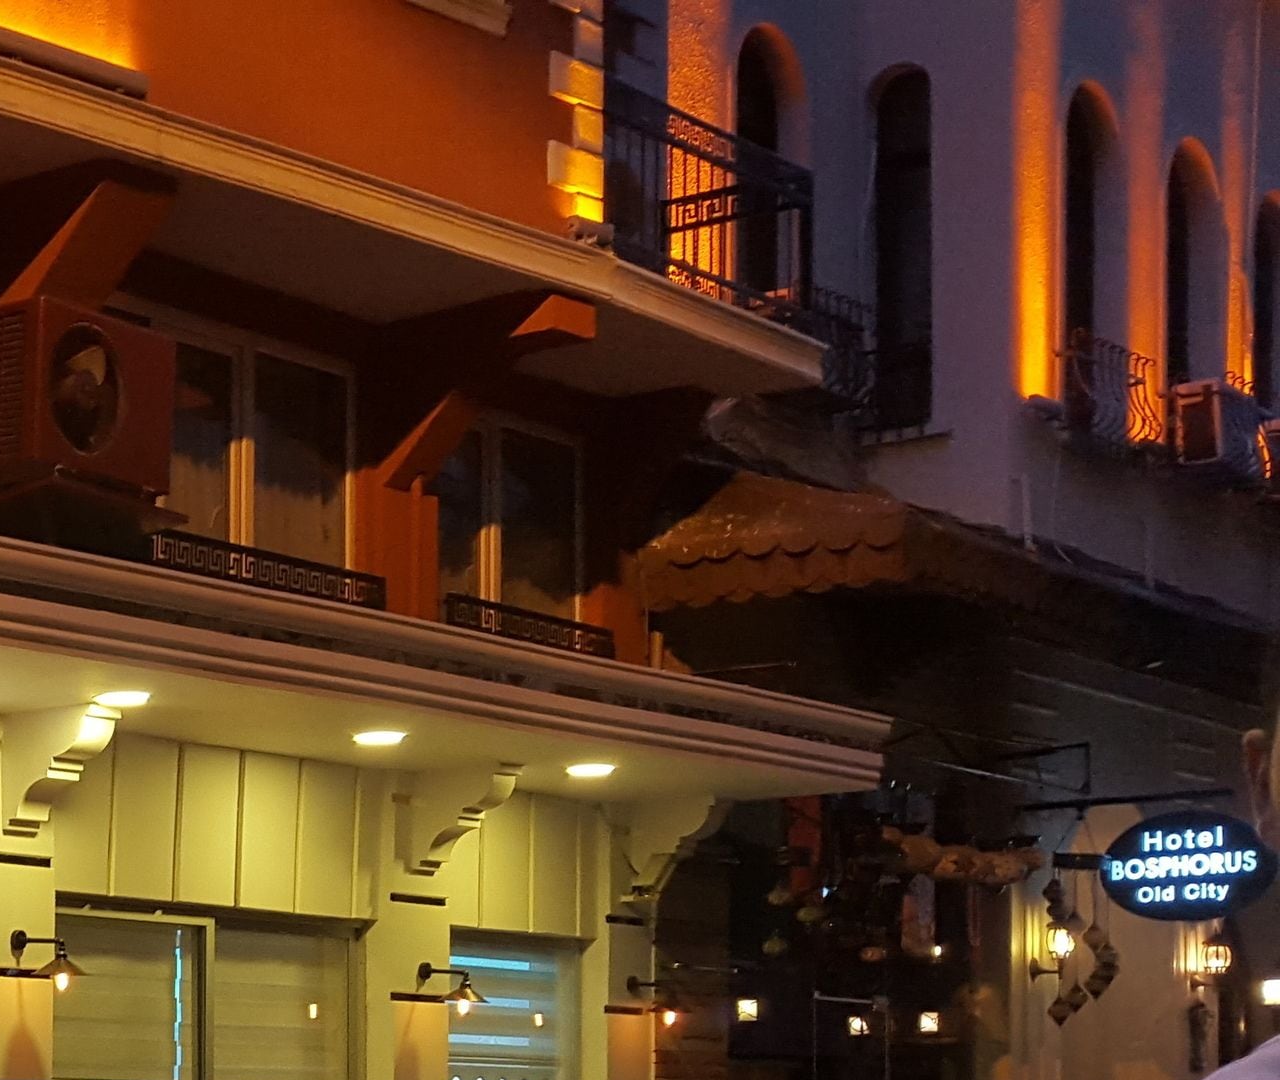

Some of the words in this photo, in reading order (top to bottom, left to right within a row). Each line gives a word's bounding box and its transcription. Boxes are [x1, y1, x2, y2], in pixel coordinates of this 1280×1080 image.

[1143, 825, 1223, 852] Hotel
[1111, 850, 1257, 881] BOSPHORUS
[1137, 885, 1176, 903] Old
[1183, 883, 1229, 901] City
